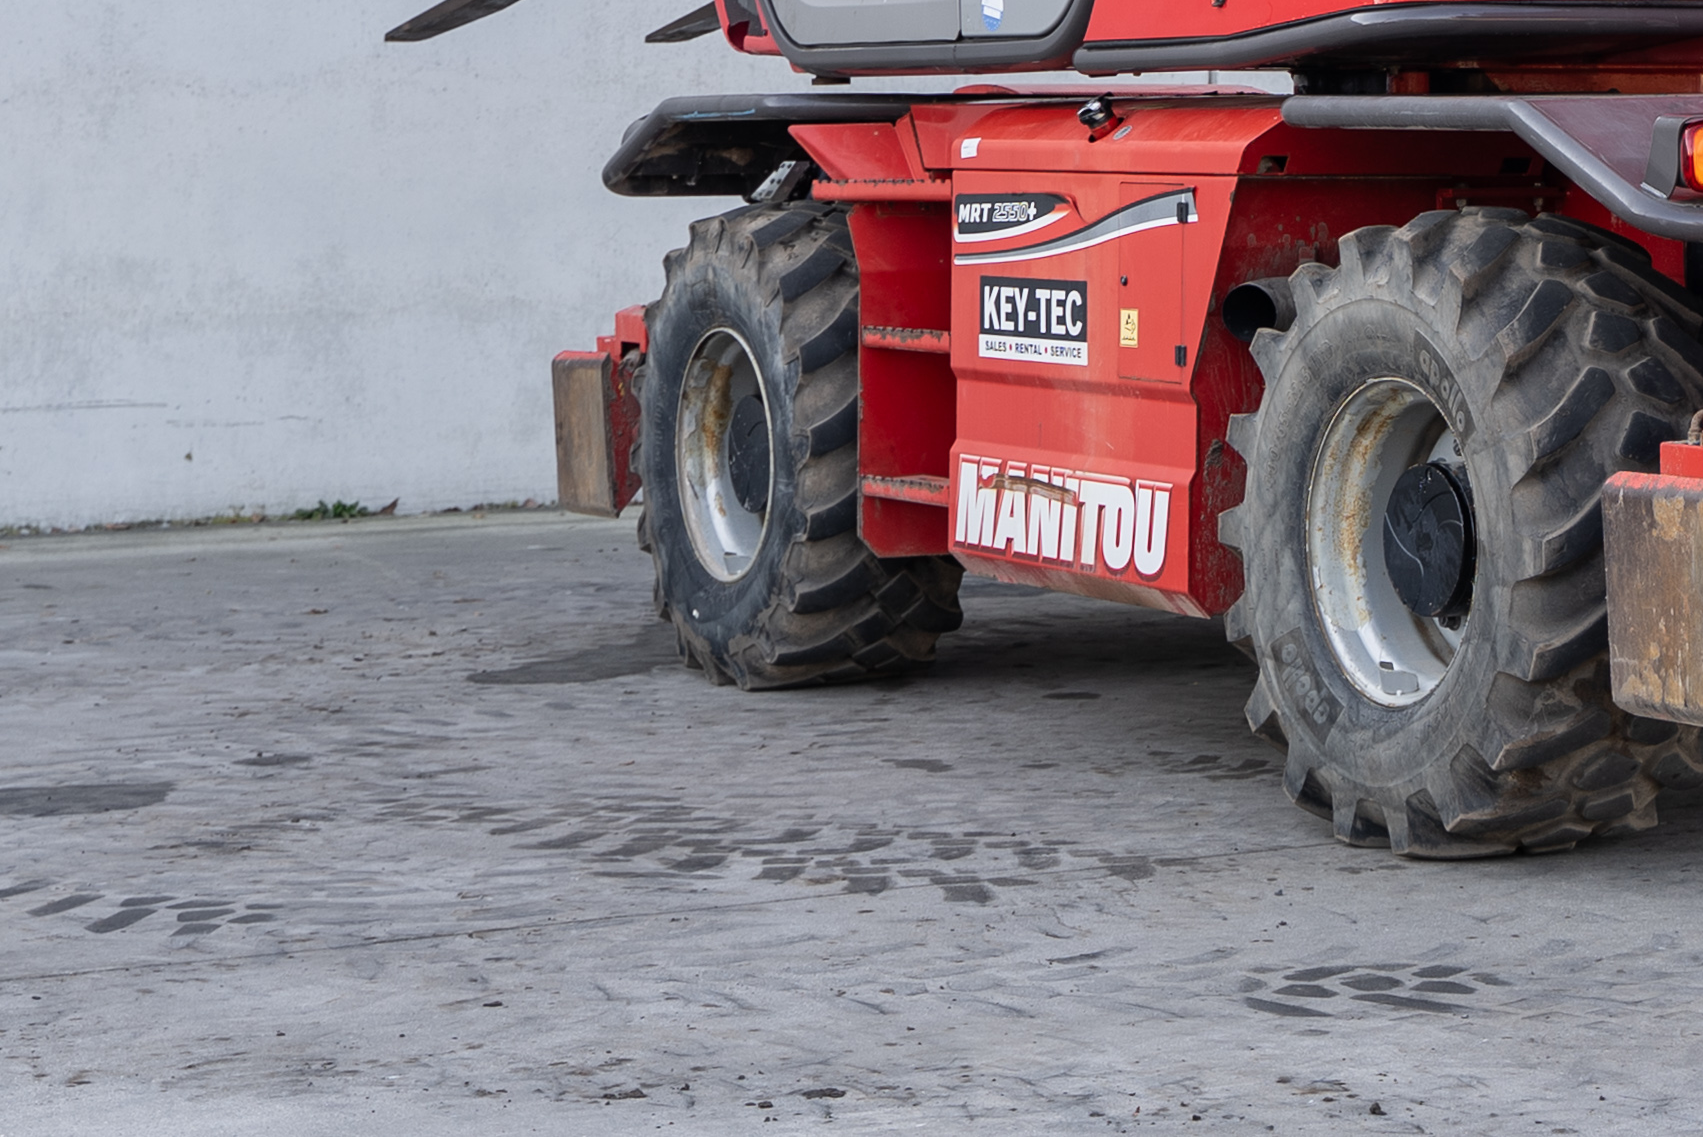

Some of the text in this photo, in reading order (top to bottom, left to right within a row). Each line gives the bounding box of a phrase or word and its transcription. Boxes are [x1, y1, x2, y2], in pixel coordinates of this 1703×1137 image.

[958, 201, 1037, 223] MRT 2550+
[983, 285, 1083, 337] KEY-TEC
[985, 340, 1082, 359] SALES RENTAL SERVICE
[1420, 349, 1466, 433] apollo
[954, 455, 1173, 579] MANITOU
[1281, 643, 1331, 725] apollo
